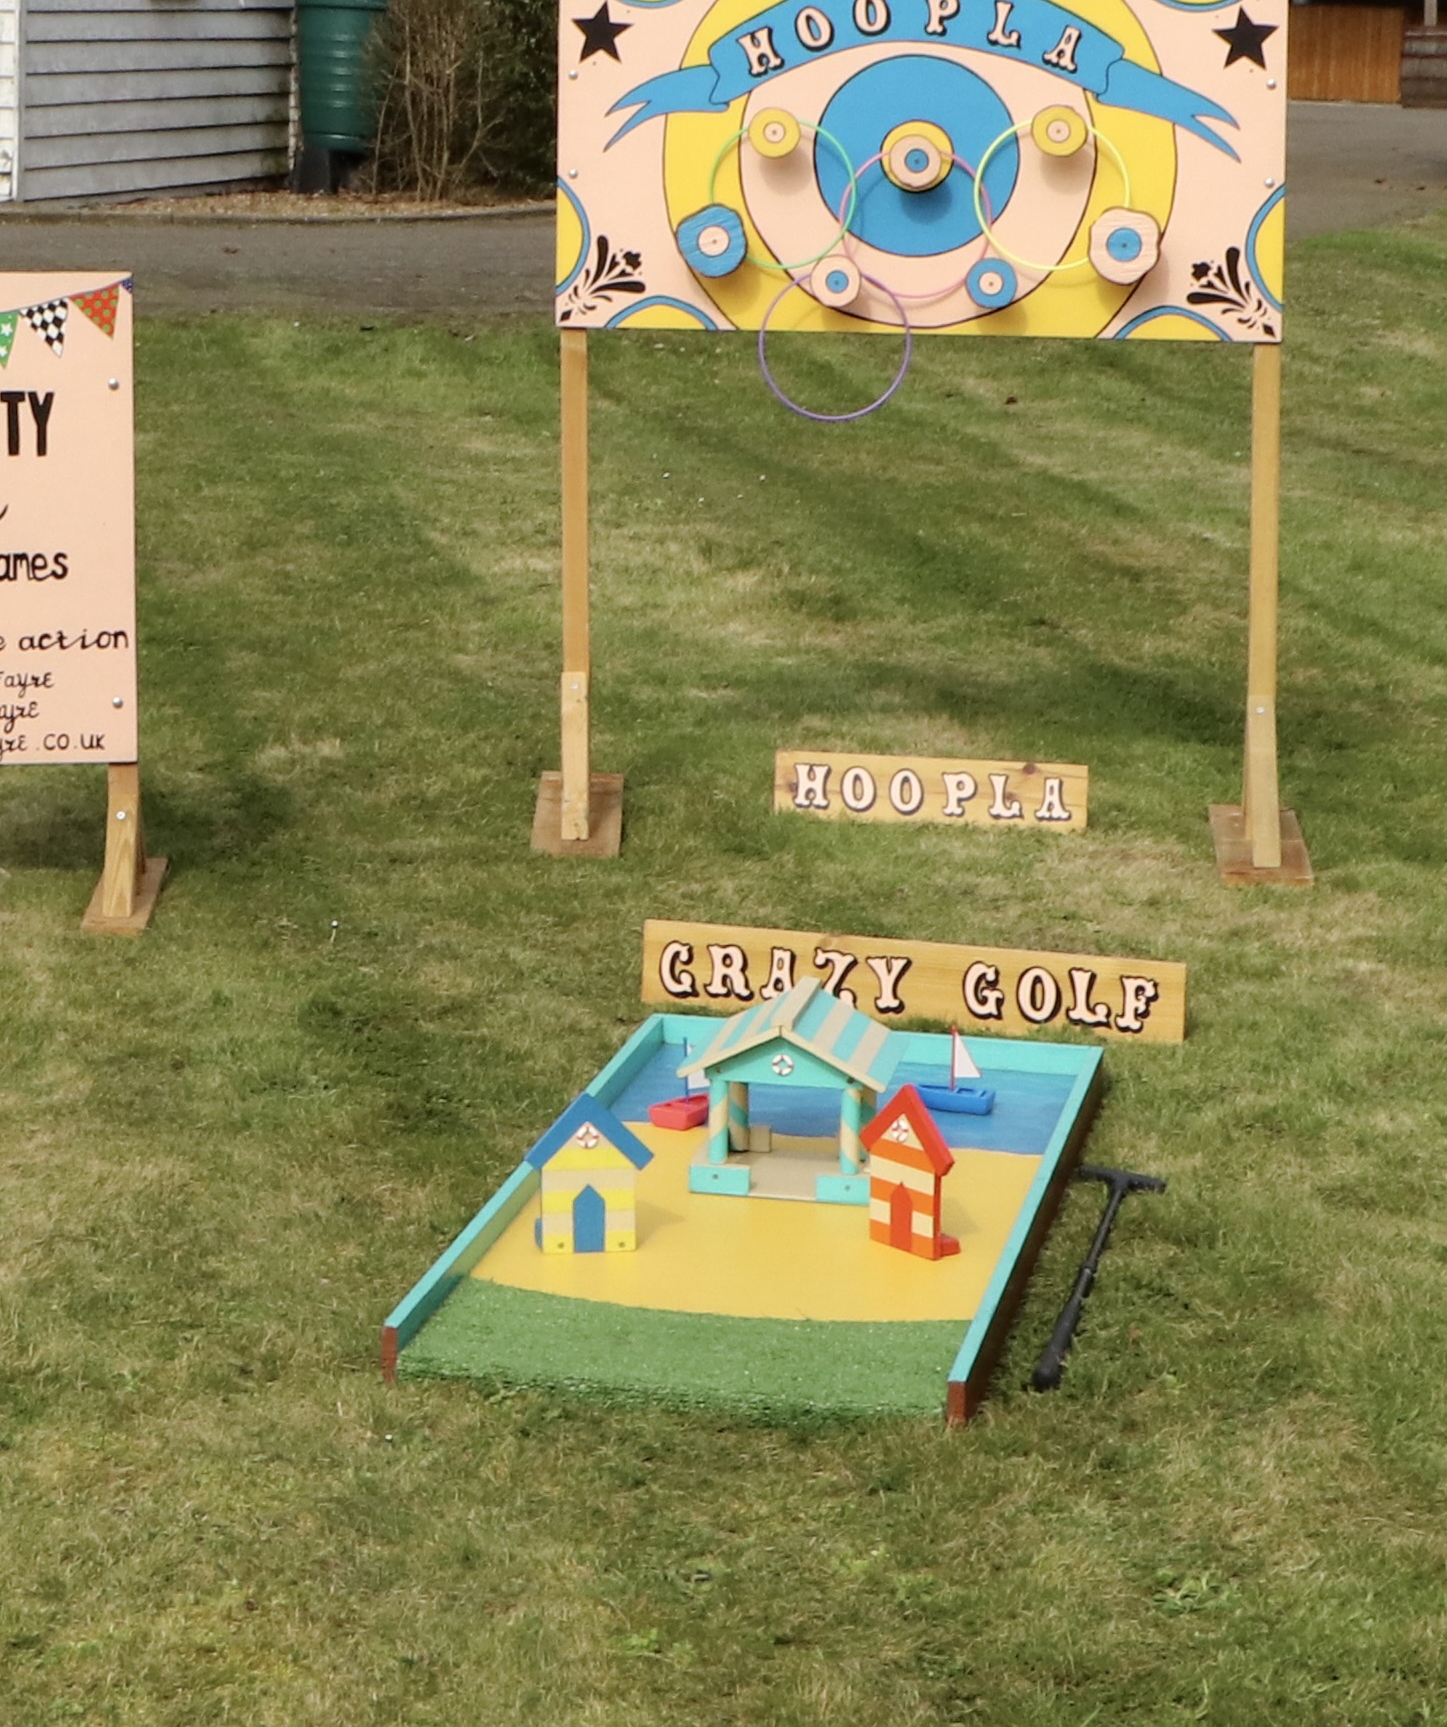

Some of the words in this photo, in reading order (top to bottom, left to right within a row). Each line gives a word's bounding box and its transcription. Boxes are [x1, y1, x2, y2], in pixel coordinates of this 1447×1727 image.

[18, 629, 129, 652] action
[793, 761, 1072, 821] HOOPLA
[659, 940, 912, 1014] CRAZY
[962, 960, 1159, 1033] GOLF
